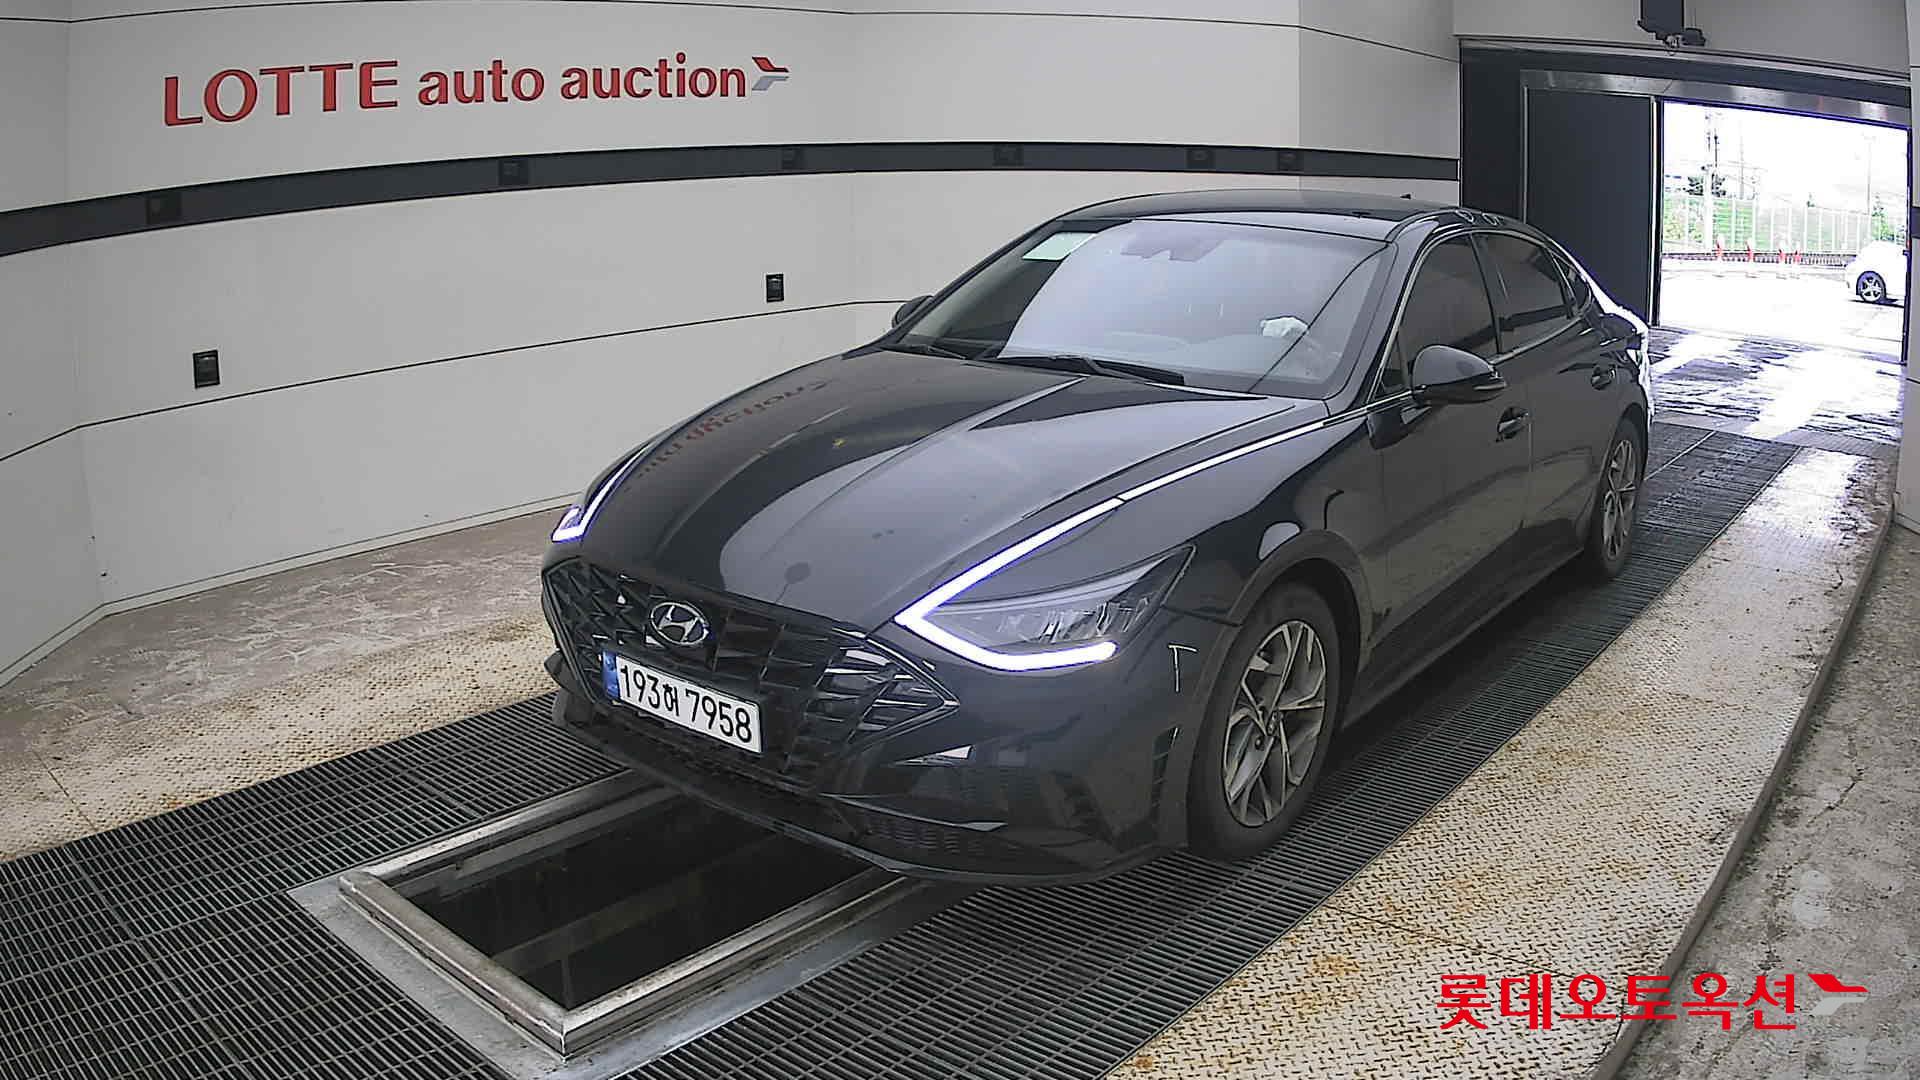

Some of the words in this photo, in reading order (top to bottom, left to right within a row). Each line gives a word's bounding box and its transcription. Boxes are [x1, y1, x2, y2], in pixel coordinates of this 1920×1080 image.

[163, 60, 398, 127] LOTTE
[417, 59, 545, 106] auto
[560, 52, 748, 99] auction
[685, 687, 753, 743] 7958
